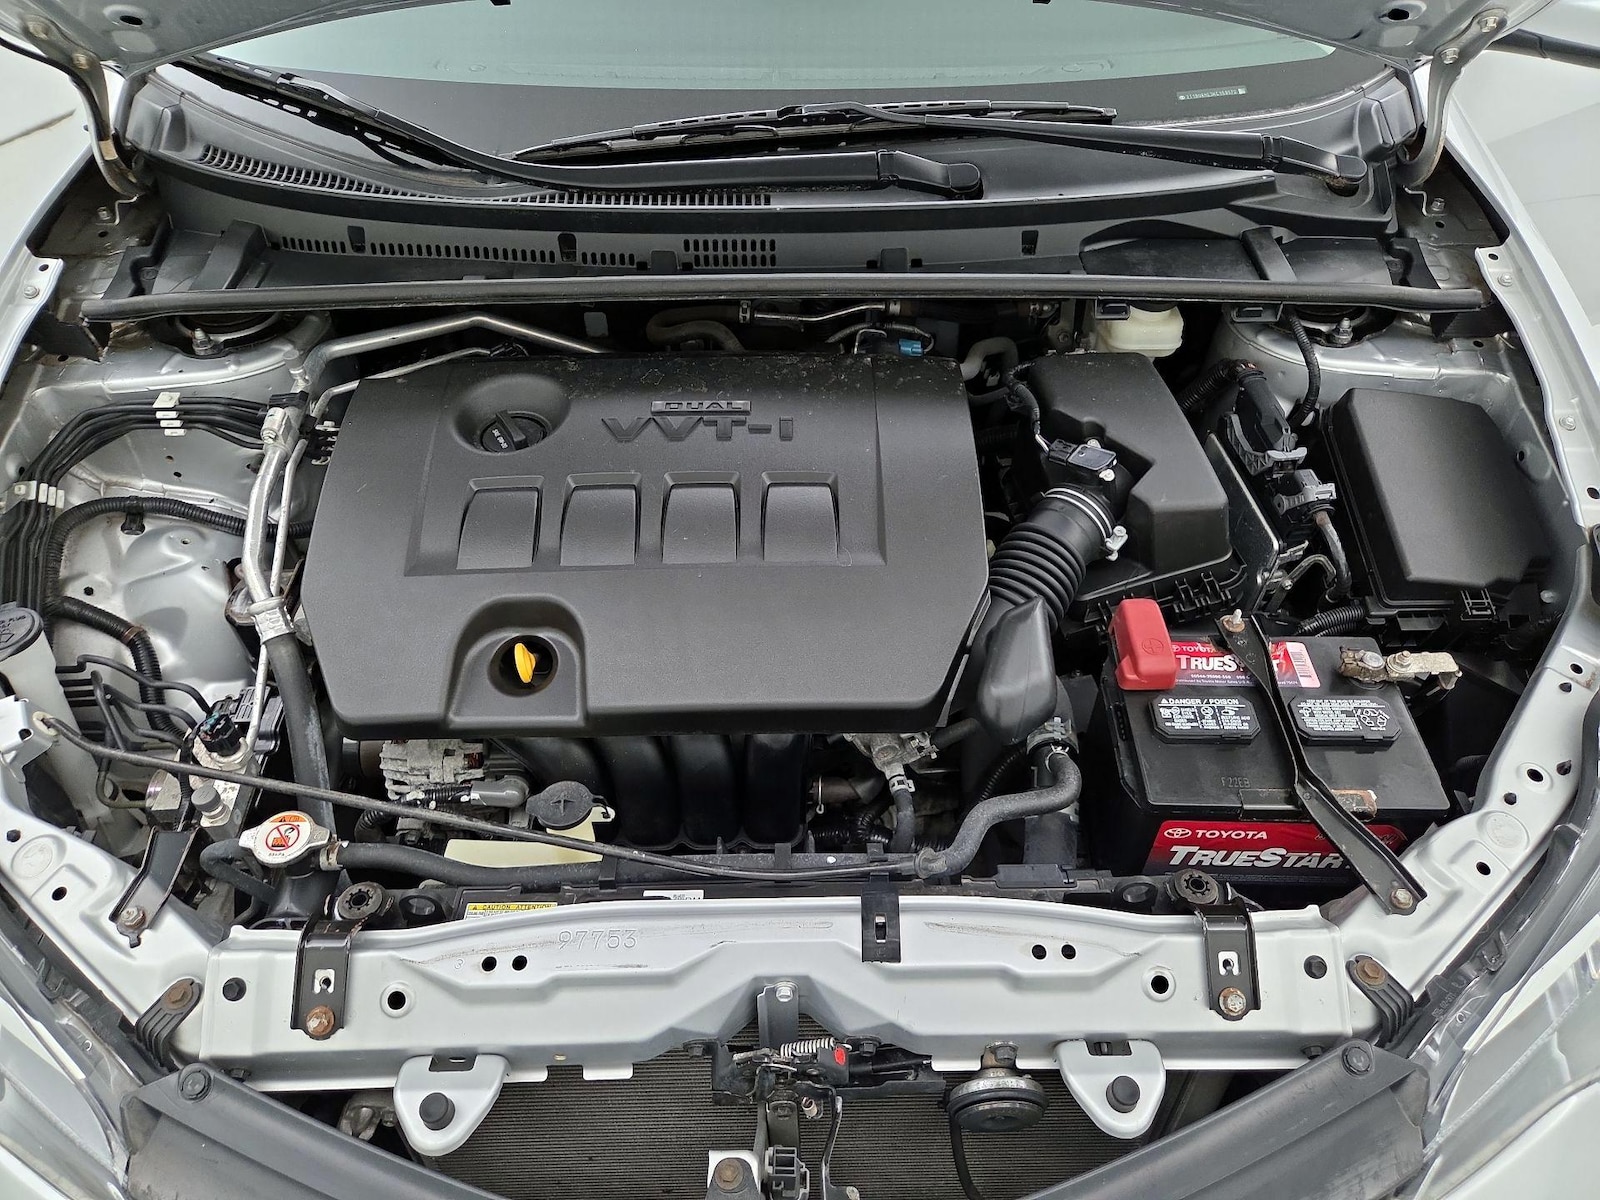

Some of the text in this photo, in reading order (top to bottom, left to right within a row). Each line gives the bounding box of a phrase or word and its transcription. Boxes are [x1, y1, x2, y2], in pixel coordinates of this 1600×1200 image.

[1168, 698, 1202, 706] DANGER
[1208, 698, 1239, 706] POISON
[1195, 829, 1268, 840] TOYOTA
[1168, 845, 1351, 870] TRUESTAR
[557, 930, 637, 951] 97753
